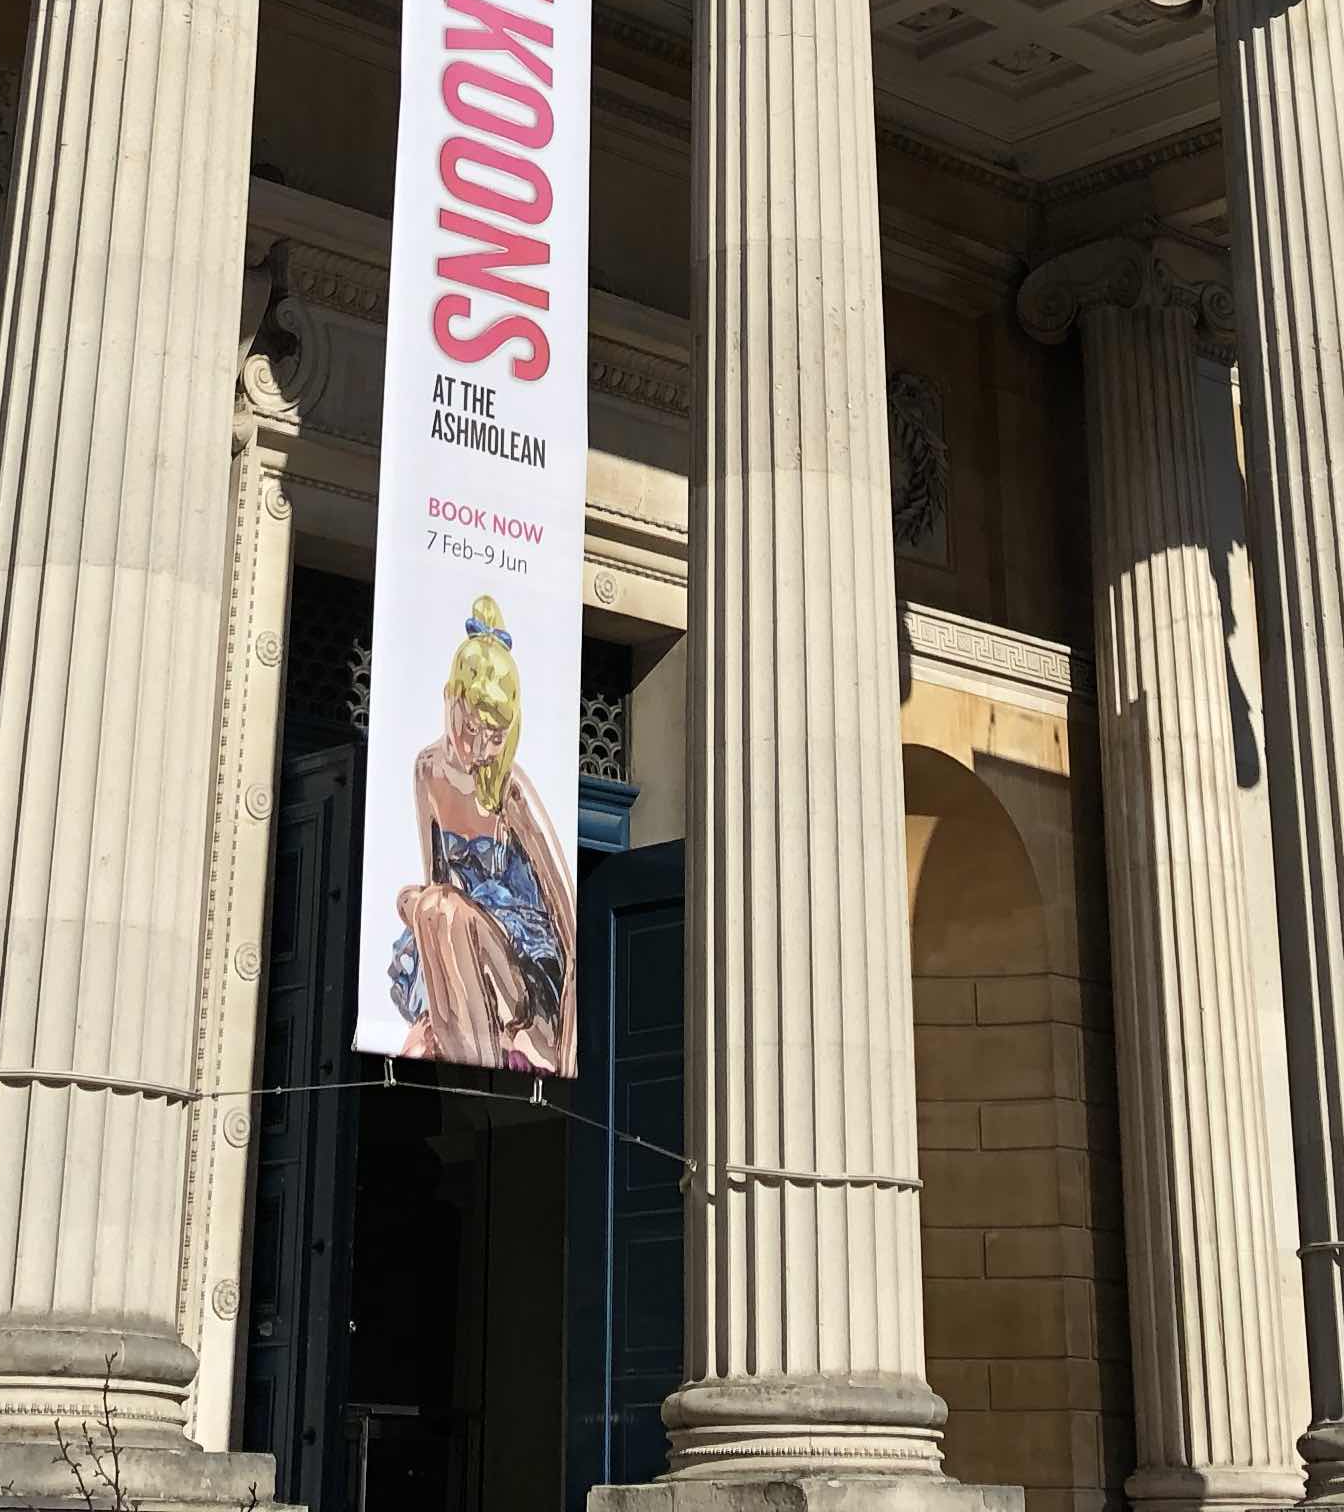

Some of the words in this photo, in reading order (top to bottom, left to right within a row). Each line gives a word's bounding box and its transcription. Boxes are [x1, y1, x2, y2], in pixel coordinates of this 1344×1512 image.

[432, 374, 456, 407] AT
[461, 381, 496, 419] THE
[431, 409, 546, 469] ASHMOLEAN
[428, 496, 486, 530] BOOK
[492, 513, 544, 545] NOW
[427, 529, 438, 550] 7
[499, 549, 528, 574] Jun
